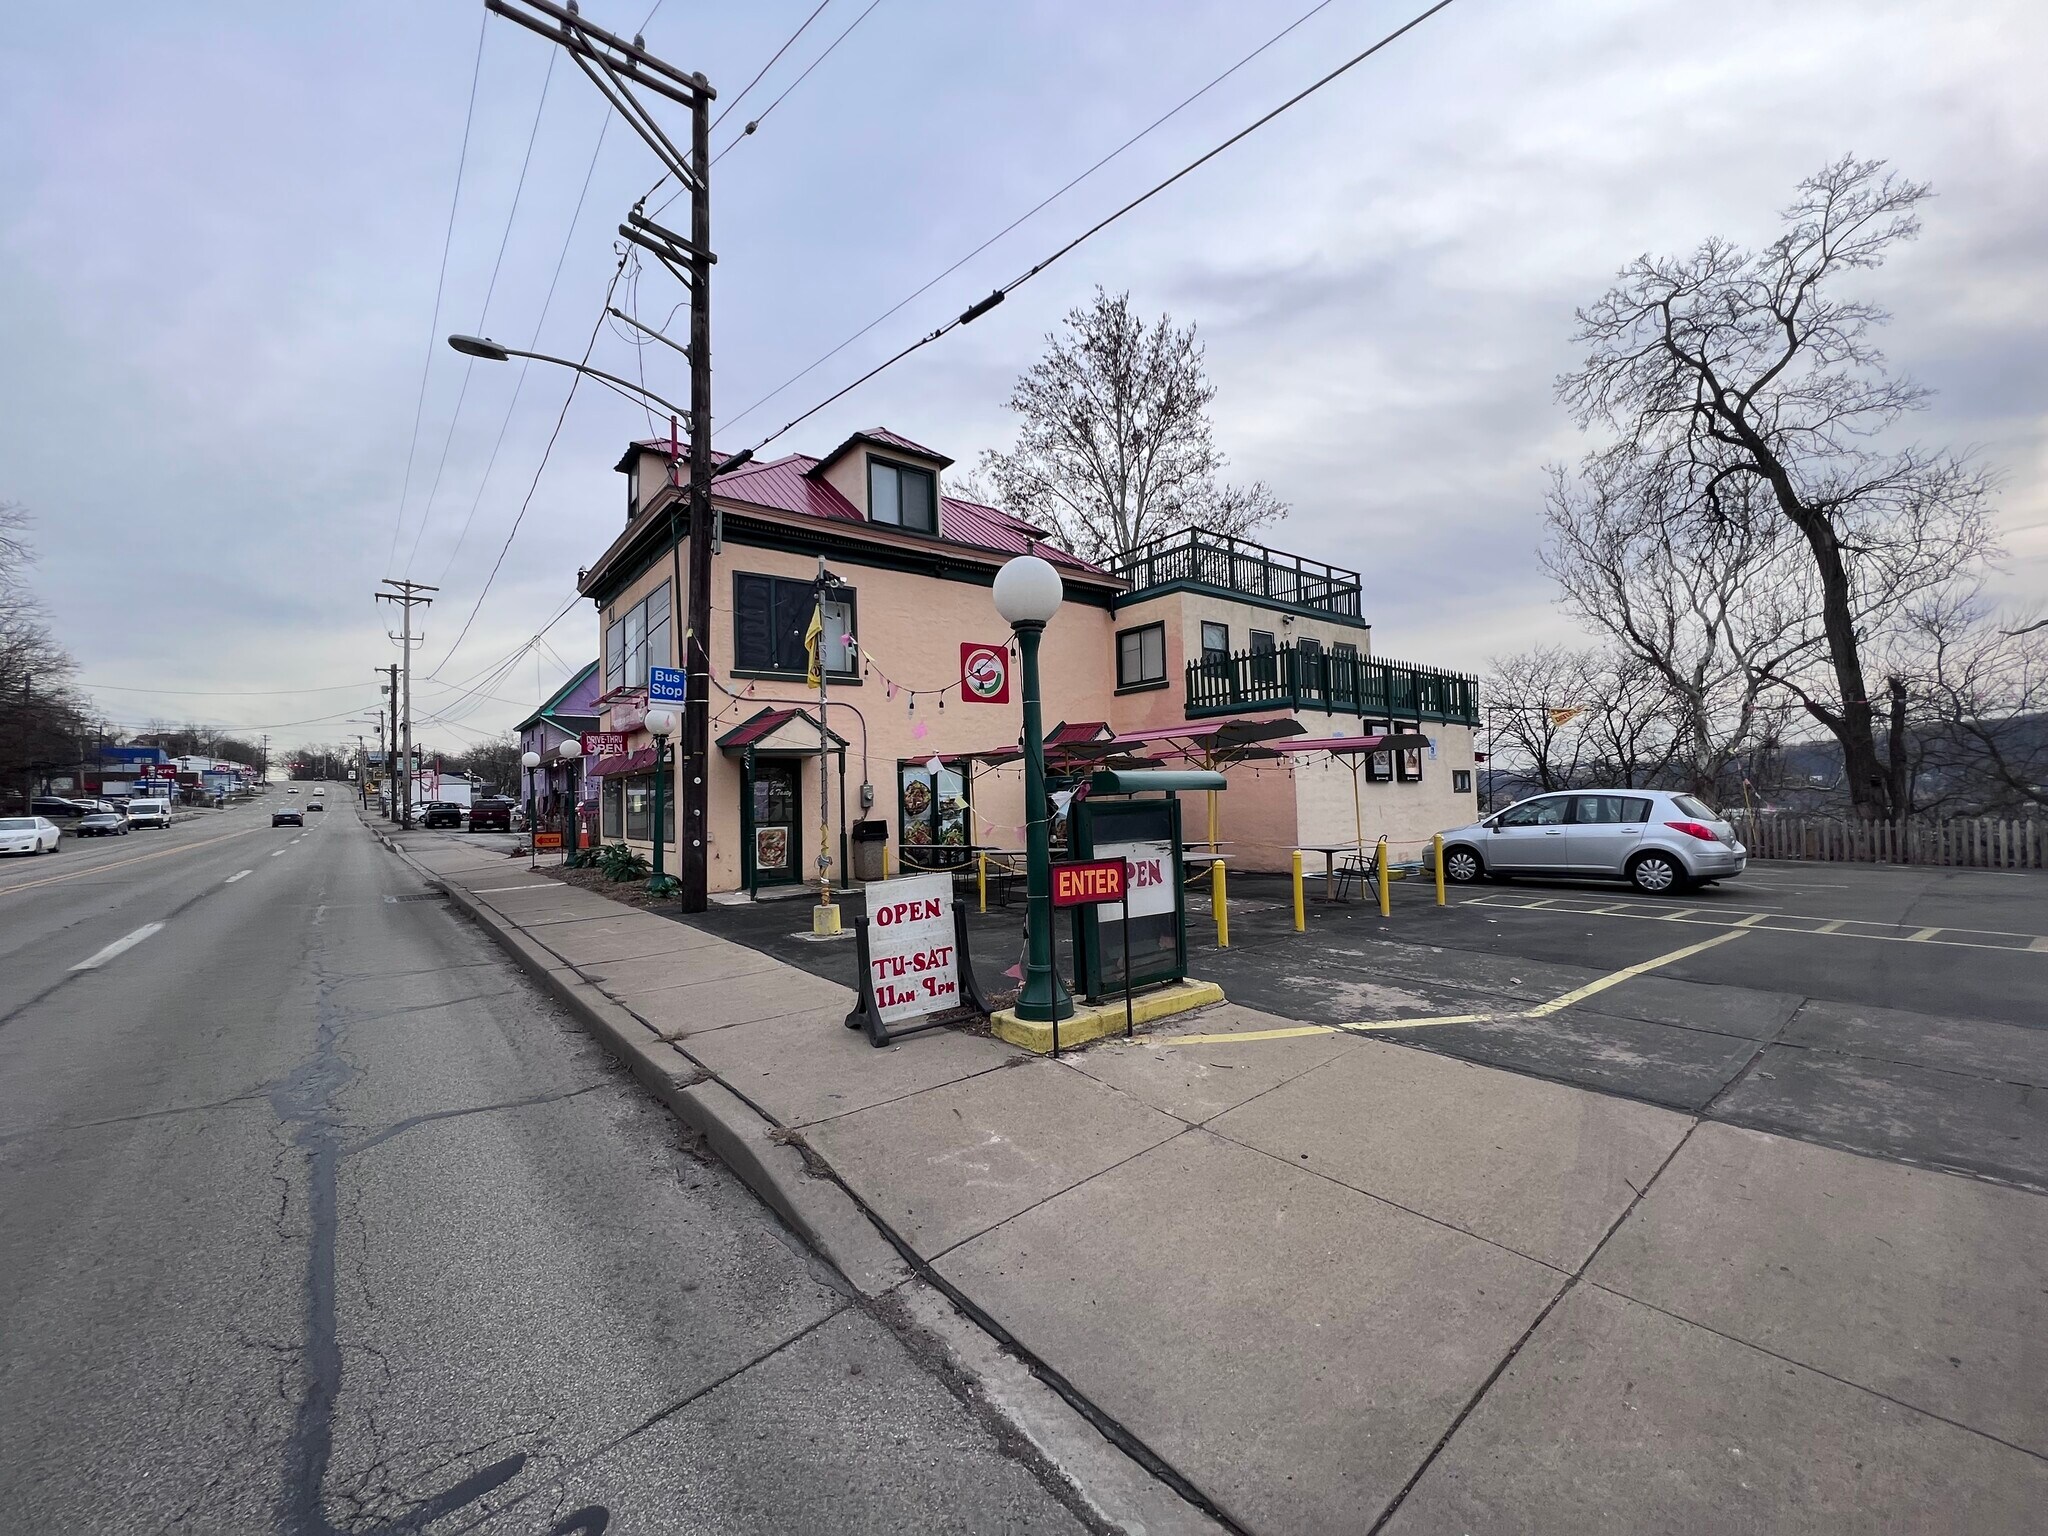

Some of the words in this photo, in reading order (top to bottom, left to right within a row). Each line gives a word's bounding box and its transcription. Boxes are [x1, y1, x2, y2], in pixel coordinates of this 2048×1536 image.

[652, 683, 682, 697] Stop
[655, 671, 680, 683] Bus
[587, 743, 623, 753] OPEN
[1059, 868, 1119, 897] ENTER
[1126, 859, 1163, 889] PEN
[876, 897, 941, 926] OPEN
[872, 946, 953, 979] TU-SAT
